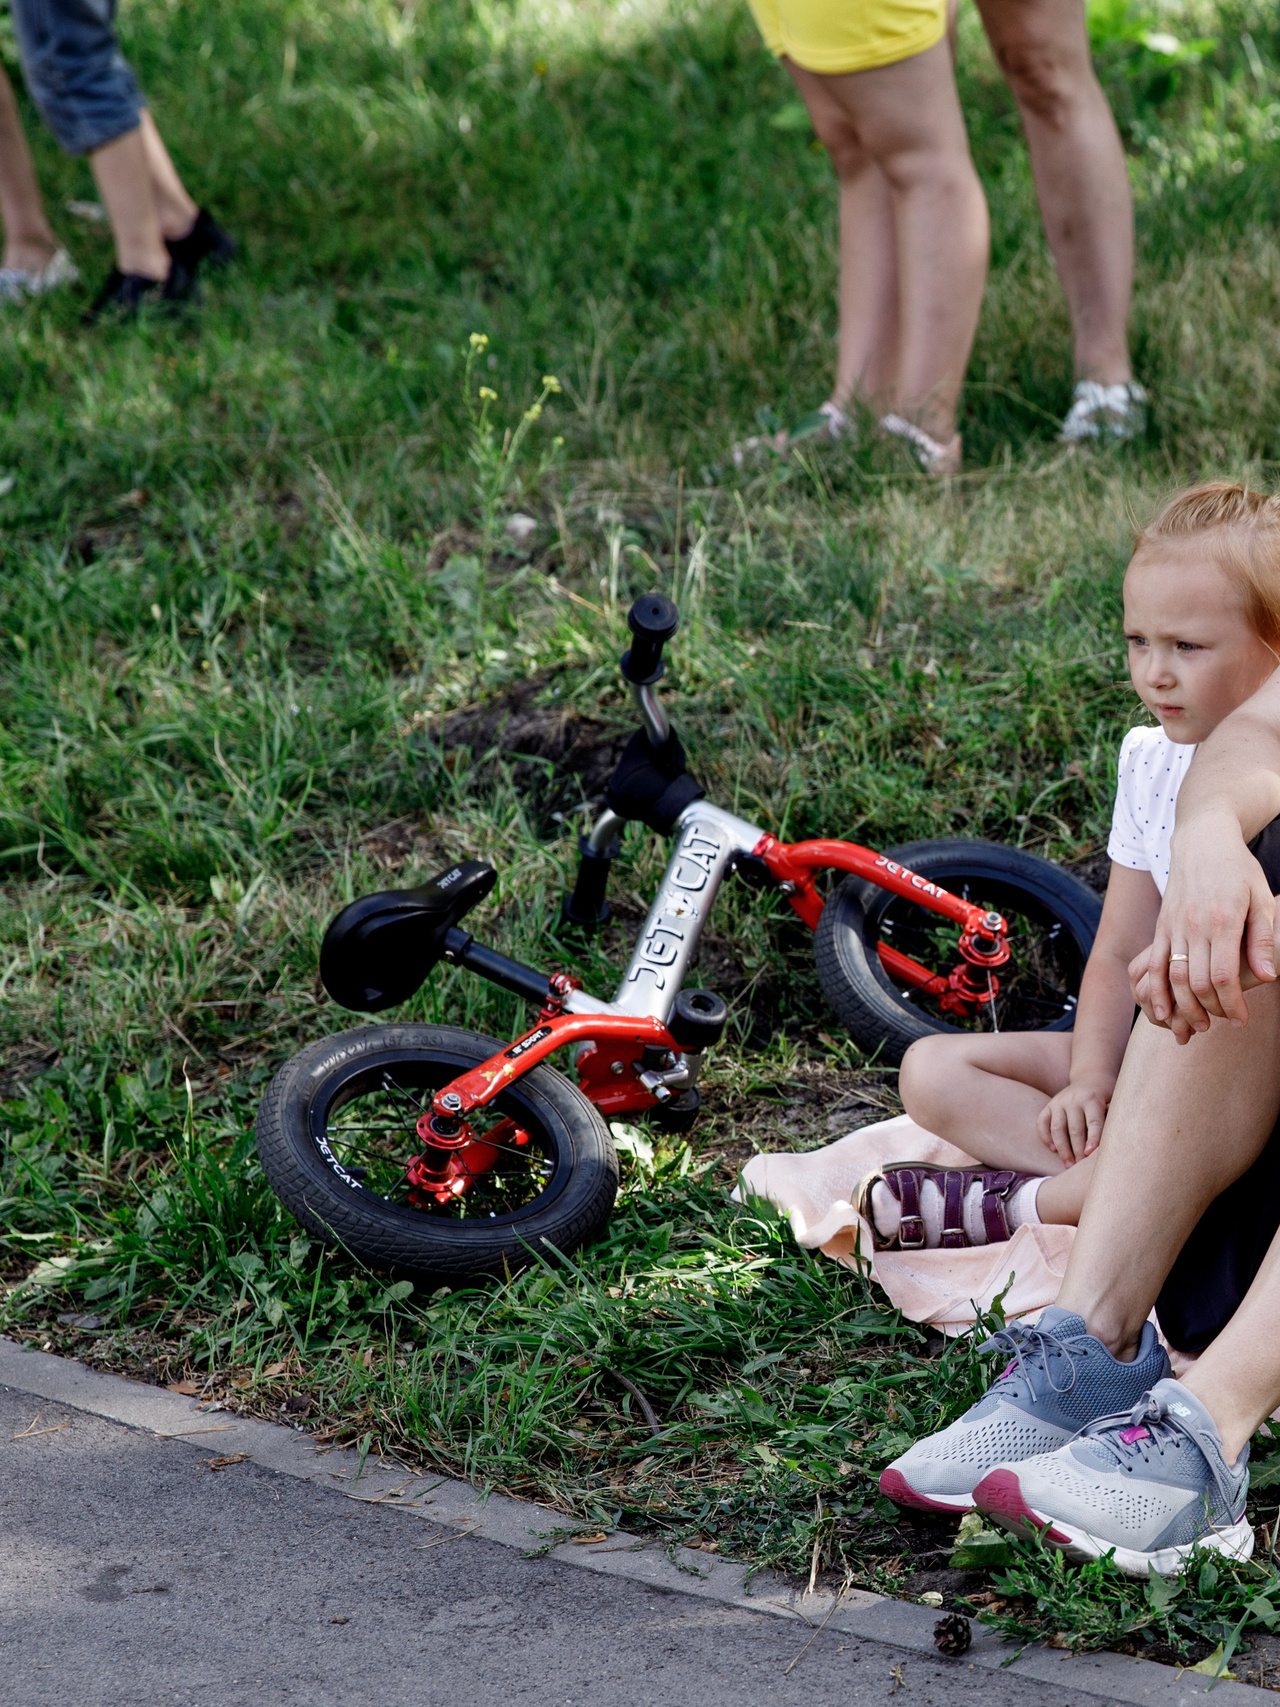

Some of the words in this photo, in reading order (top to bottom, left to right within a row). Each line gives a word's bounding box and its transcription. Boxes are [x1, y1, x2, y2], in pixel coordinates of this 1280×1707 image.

[874, 855, 949, 898] JETCAT
[628, 918, 684, 990] JET
[669, 827, 720, 891] CAT
[315, 1136, 363, 1188] JETCAT
